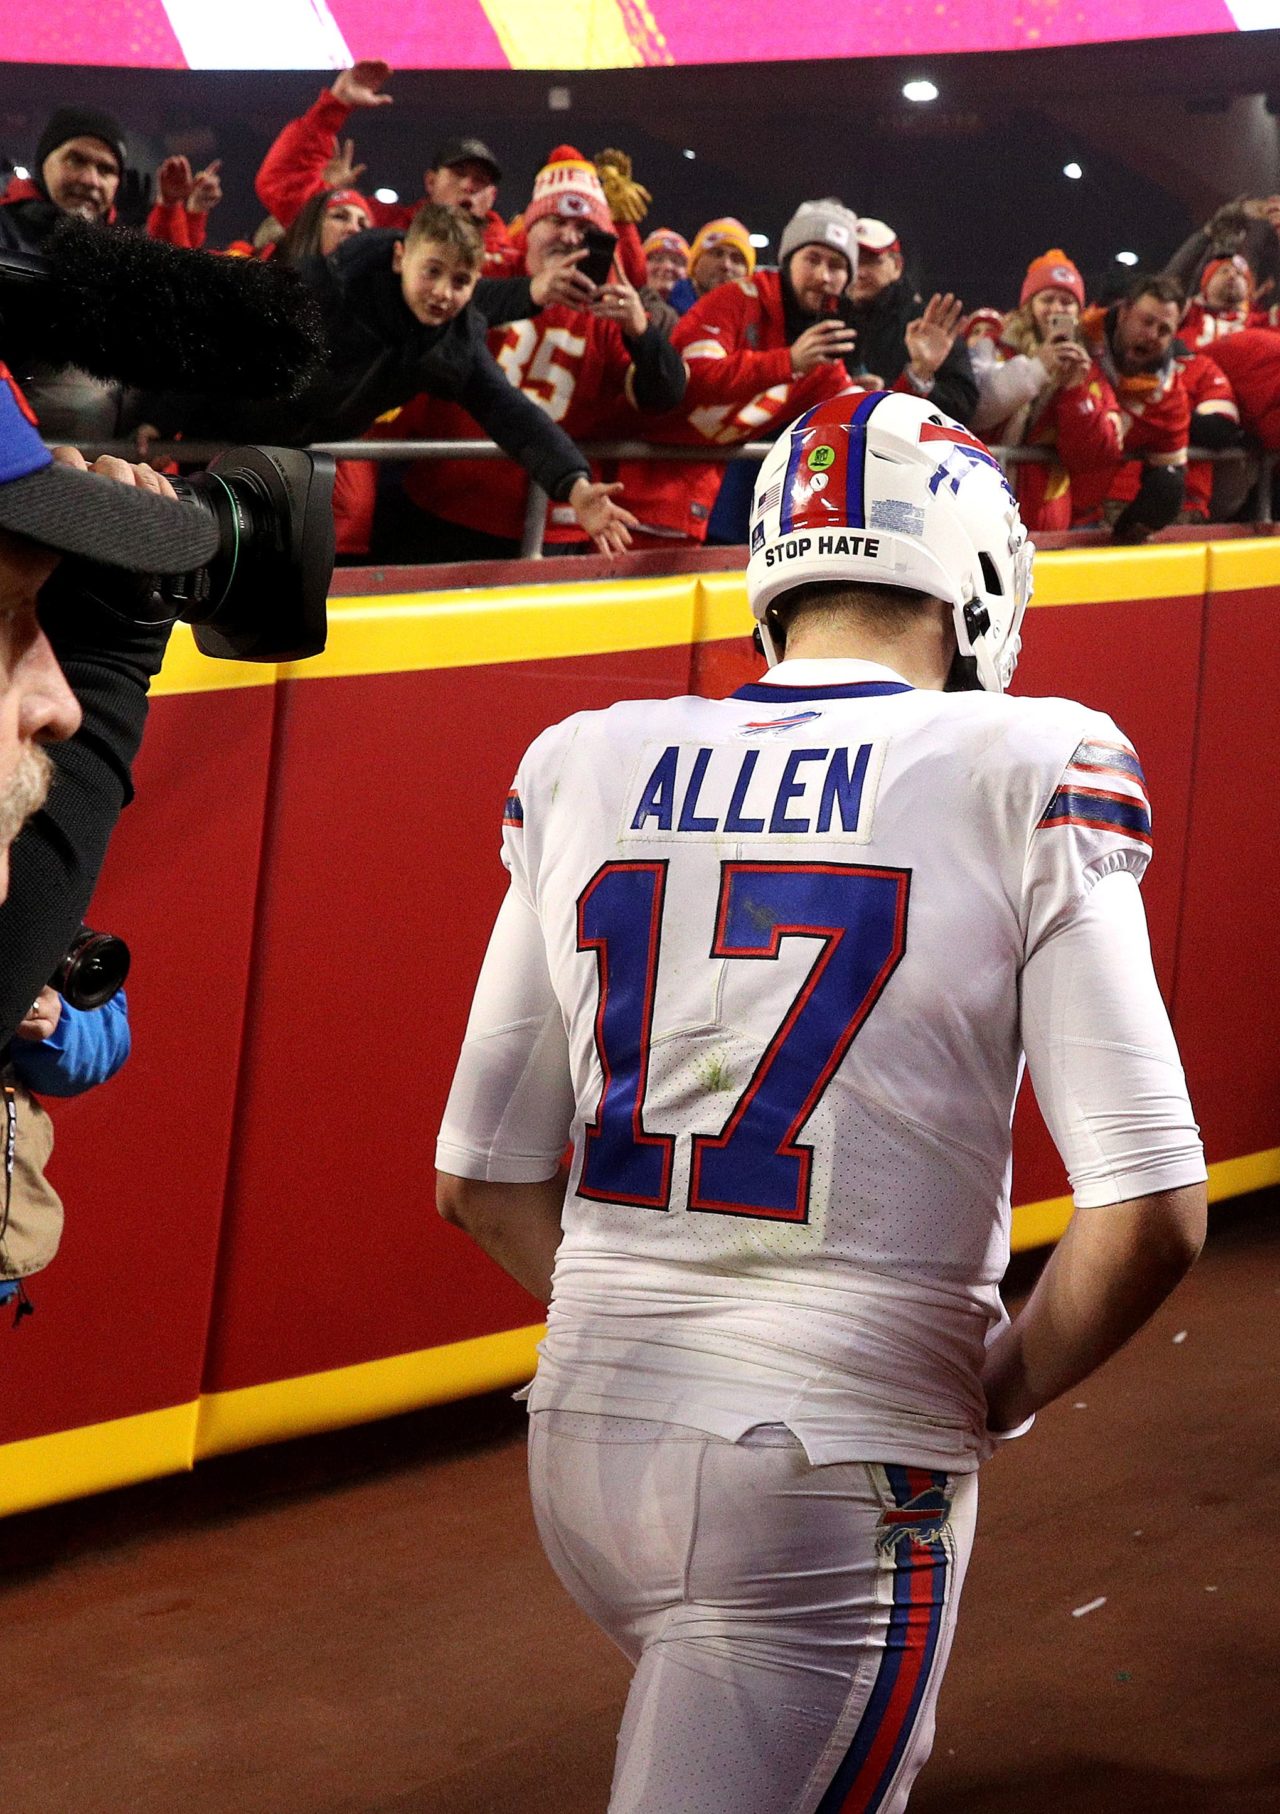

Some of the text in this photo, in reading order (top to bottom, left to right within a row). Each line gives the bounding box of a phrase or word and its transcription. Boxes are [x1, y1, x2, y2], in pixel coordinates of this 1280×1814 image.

[765, 537, 811, 567] STOP
[818, 536, 880, 558] HATE
[630, 743, 873, 833] ALLEN
[575, 859, 912, 1224] 17
